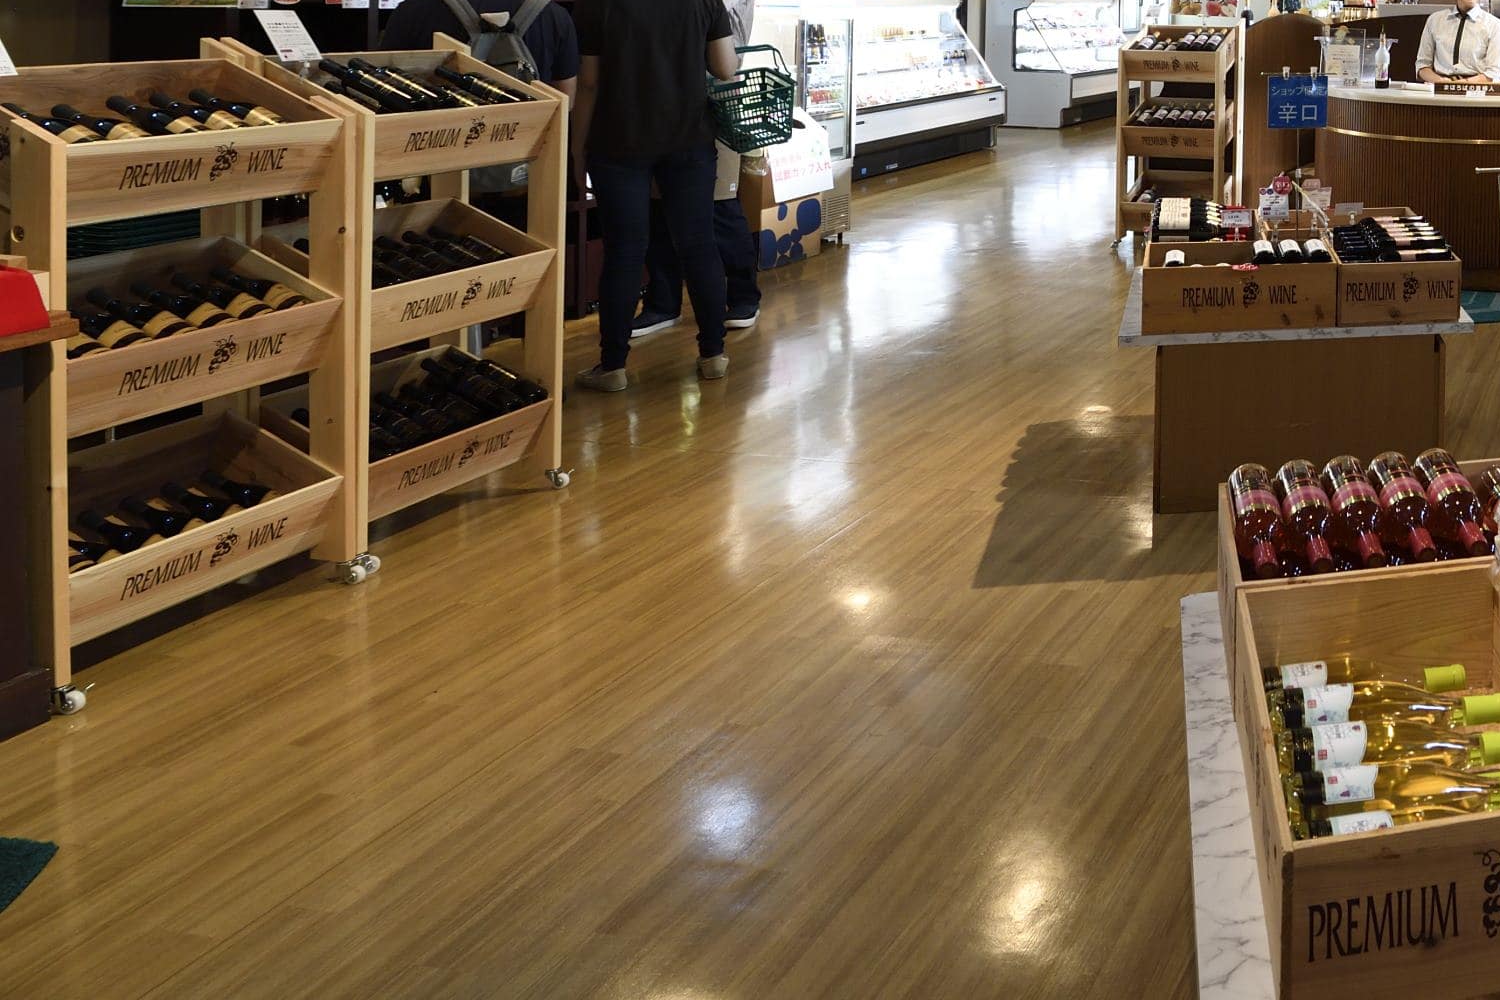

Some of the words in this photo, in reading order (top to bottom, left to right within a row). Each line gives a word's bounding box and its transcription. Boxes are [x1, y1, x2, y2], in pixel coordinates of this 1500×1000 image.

[1182, 61, 1200, 72] WINE
[1278, 102, 1317, 124] 辛口
[404, 128, 462, 153] PREMIUM
[488, 122, 520, 143] WINE
[118, 157, 202, 190] PREMIUM
[246, 147, 288, 174] WINE
[401, 294, 458, 322] PREMIUM
[487, 276, 517, 301] WINE
[1182, 286, 1235, 308] PREMIUM
[1268, 284, 1298, 305] WINE
[1345, 282, 1396, 302] PREMIUM
[1427, 279, 1456, 300] WINE
[117, 353, 201, 396] PREMIUM
[246, 333, 287, 362] WINE
[398, 455, 456, 491] PREMIUM
[484, 430, 514, 457] WINE
[120, 550, 202, 601] PREMIUM
[247, 517, 288, 550] WINE
[1307, 881, 1460, 963] PREMIUM
